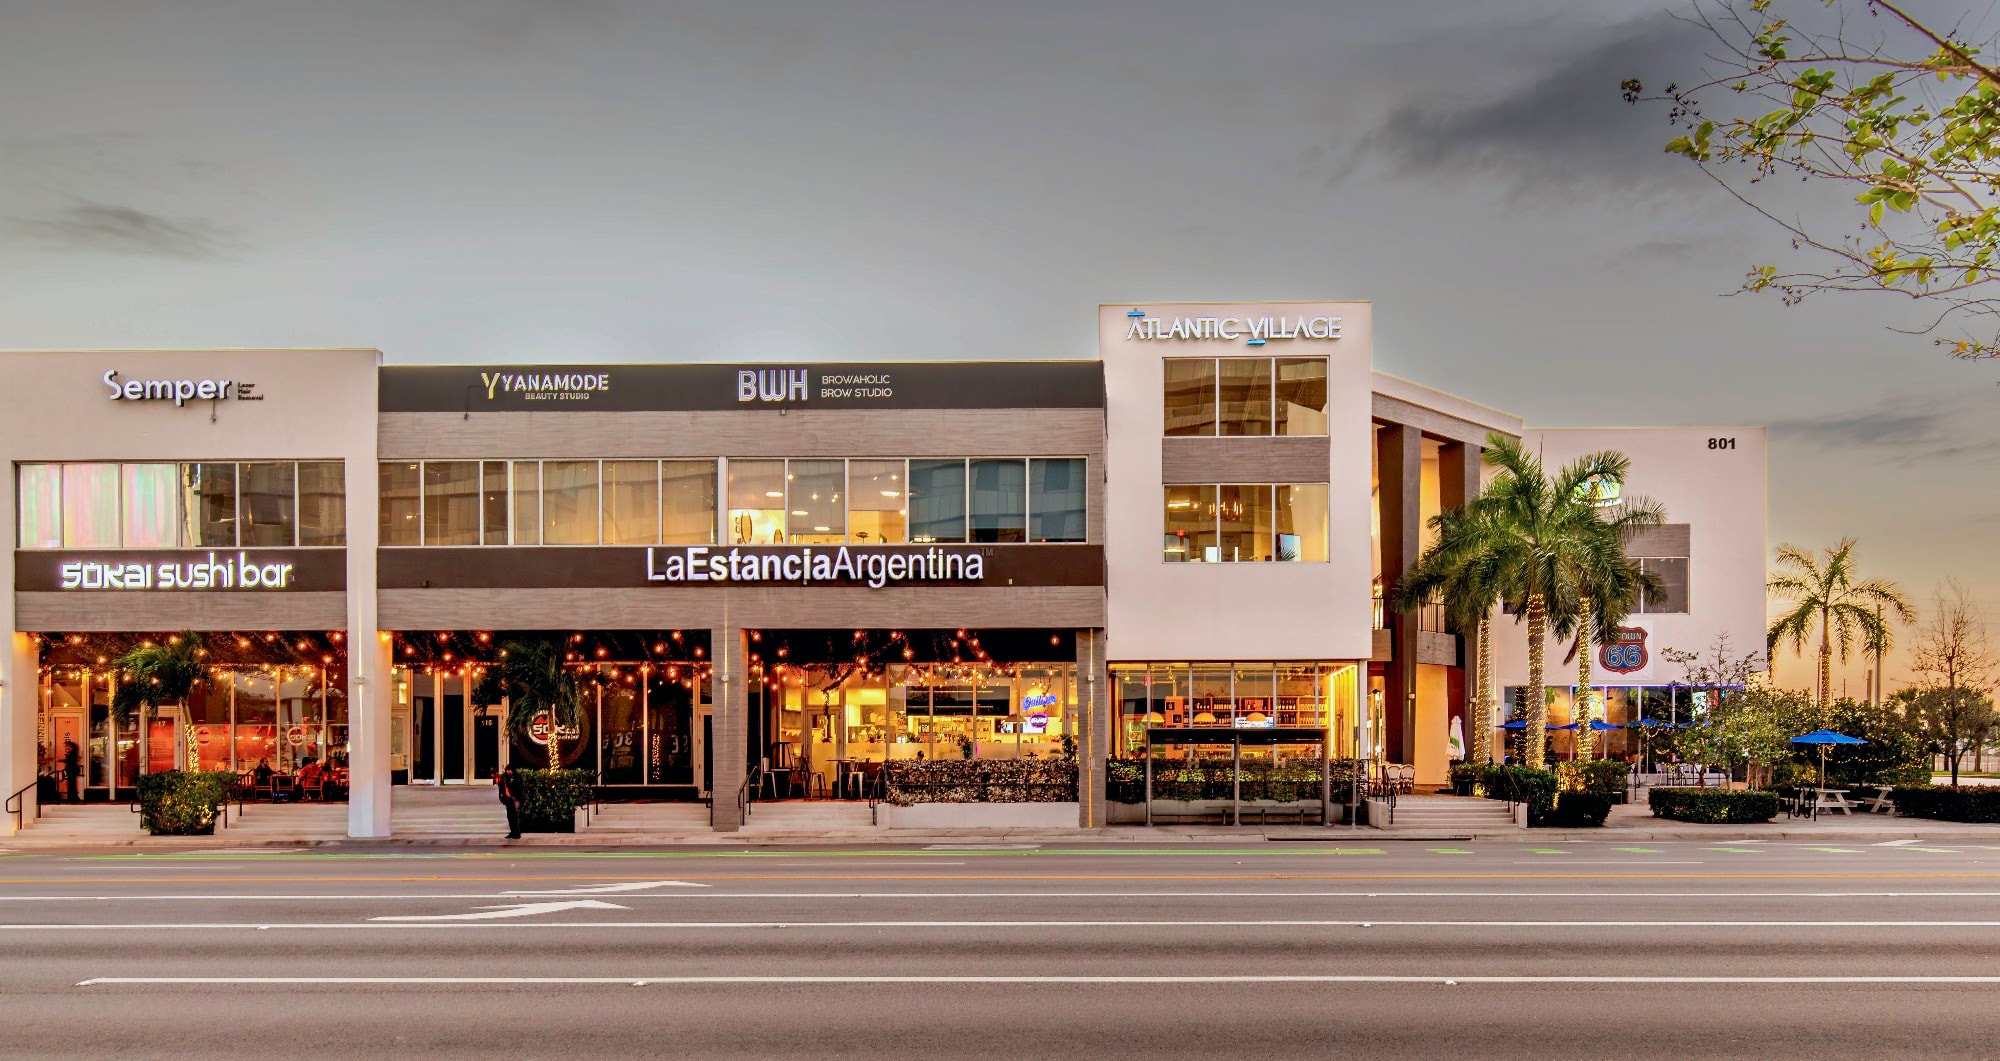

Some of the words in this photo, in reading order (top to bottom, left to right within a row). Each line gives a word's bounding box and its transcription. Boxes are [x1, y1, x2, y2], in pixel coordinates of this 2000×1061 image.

[1127, 308, 1240, 340] ATLANTIC
[1247, 316, 1342, 345] VILLAGE
[103, 369, 232, 407] Semper
[502, 374, 609, 391] YANAMODE
[738, 369, 808, 402] BWH
[822, 375, 890, 384] BROWAHOLIC
[525, 392, 557, 400] BEAUTY
[559, 392, 590, 400] STUDIO
[821, 388, 852, 398] BROW
[854, 388, 892, 398] STUDIO
[1707, 437, 1736, 450] 801
[157, 552, 236, 588] sushi
[239, 552, 293, 588] bar
[647, 547, 984, 588] LaEstanciaArgentina
[1605, 645, 1642, 667] 66
